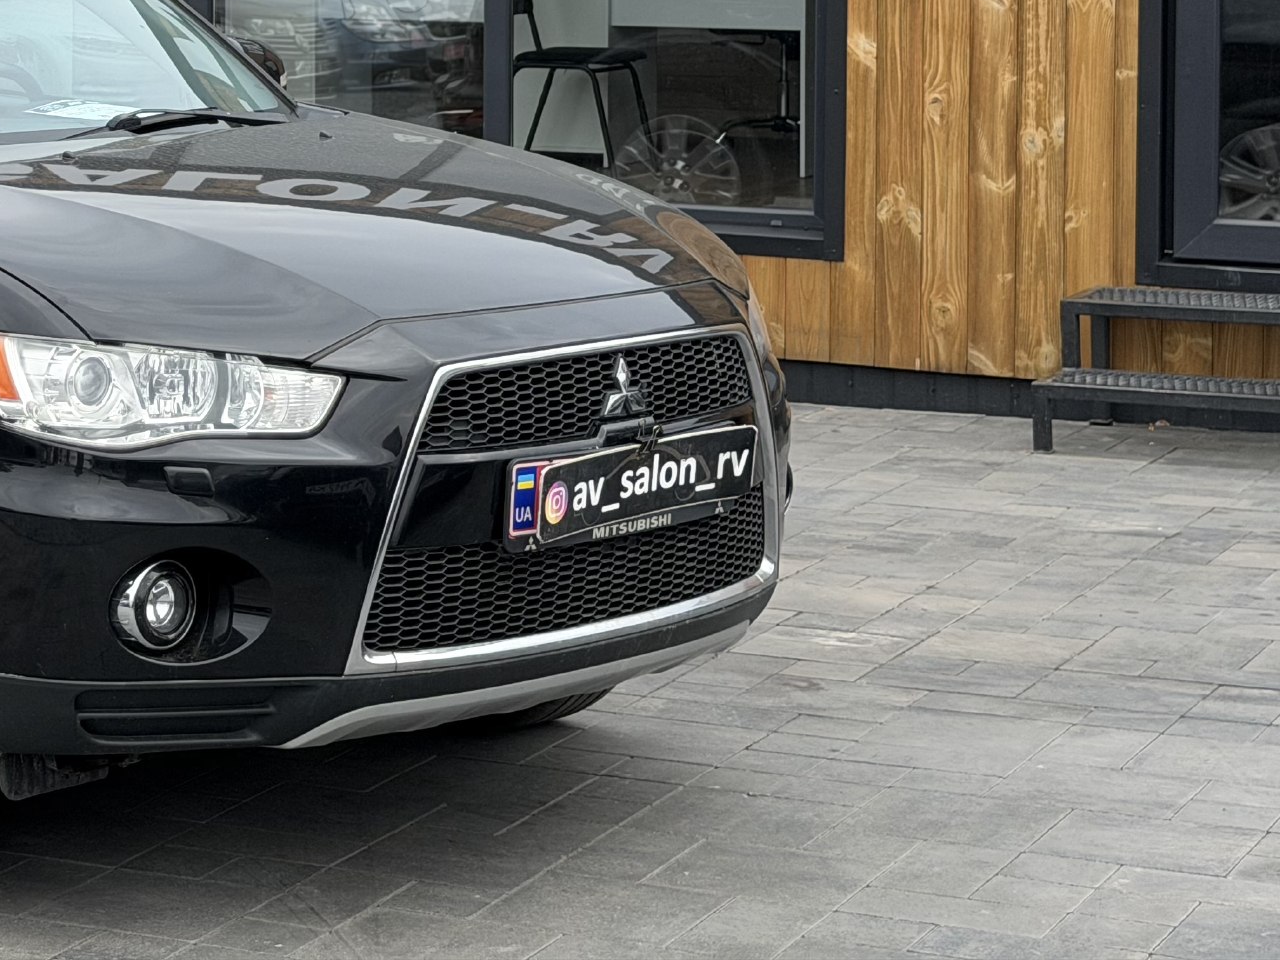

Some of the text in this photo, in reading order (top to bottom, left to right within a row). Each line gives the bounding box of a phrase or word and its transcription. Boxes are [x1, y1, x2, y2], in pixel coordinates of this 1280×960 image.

[572, 448, 750, 513] av_salon_rv
[515, 505, 533, 523] UA
[592, 513, 672, 540] MITSUBISHI
